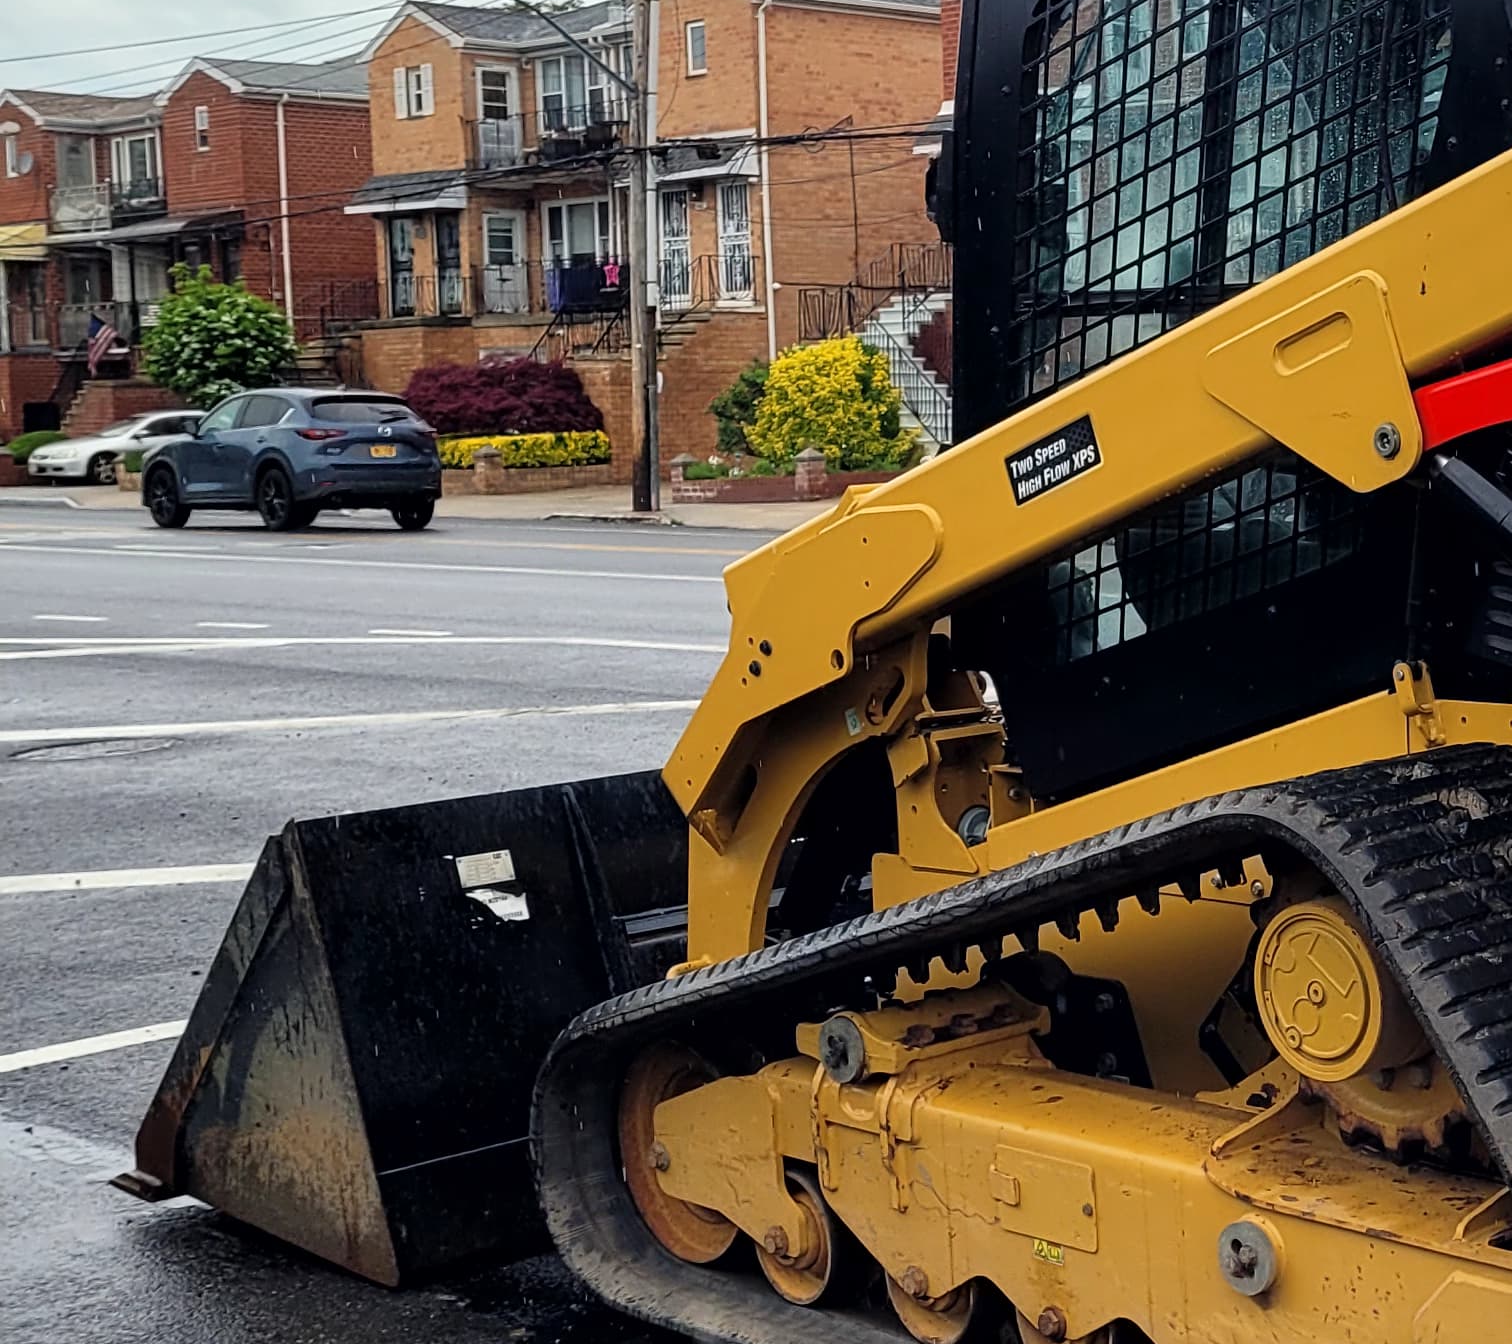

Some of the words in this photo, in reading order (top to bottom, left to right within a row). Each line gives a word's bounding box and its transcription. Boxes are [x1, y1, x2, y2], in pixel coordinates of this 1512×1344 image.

[1010, 455, 1034, 480] TWO
[1034, 438, 1067, 467] SPEED
[1017, 474, 1043, 500] HIGH
[1043, 459, 1071, 486] FLOW
[1071, 444, 1096, 472] XPS
